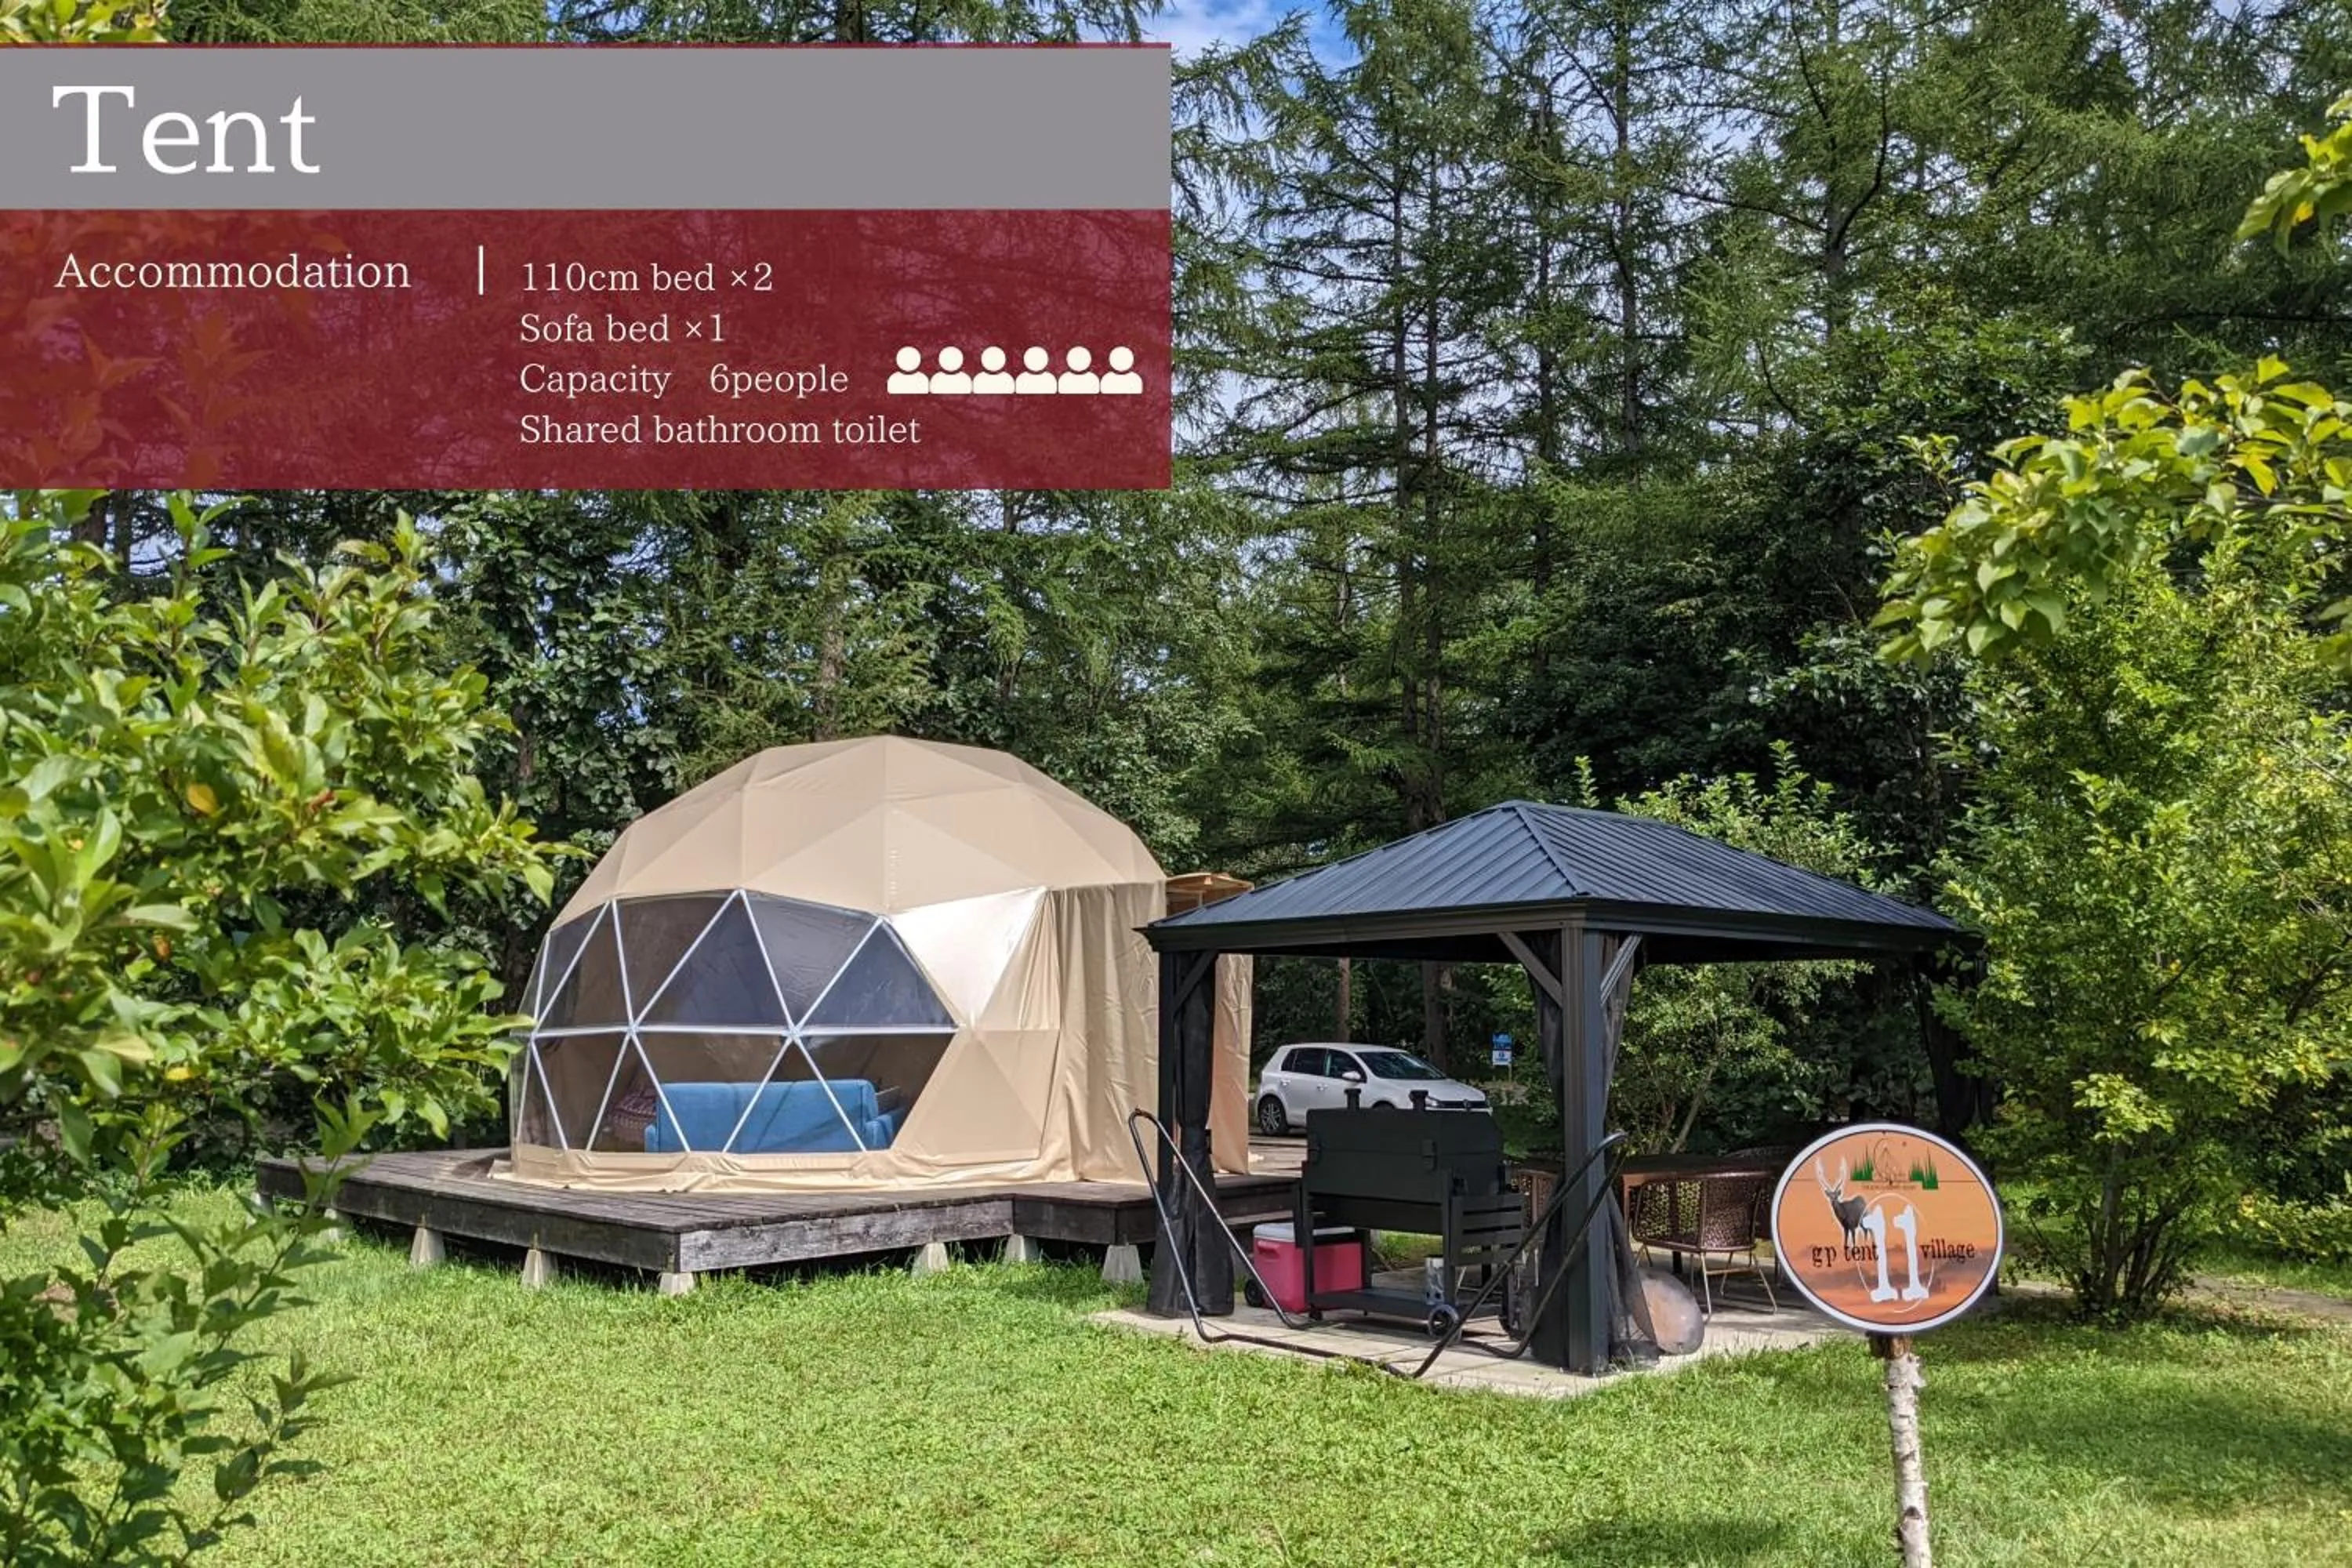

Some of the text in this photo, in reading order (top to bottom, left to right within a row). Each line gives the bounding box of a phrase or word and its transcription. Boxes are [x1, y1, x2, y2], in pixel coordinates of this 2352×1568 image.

[1812, 1245, 1837, 1267] gp
[1920, 1239, 1975, 1263] village
[1862, 1203, 1929, 1302] 11
